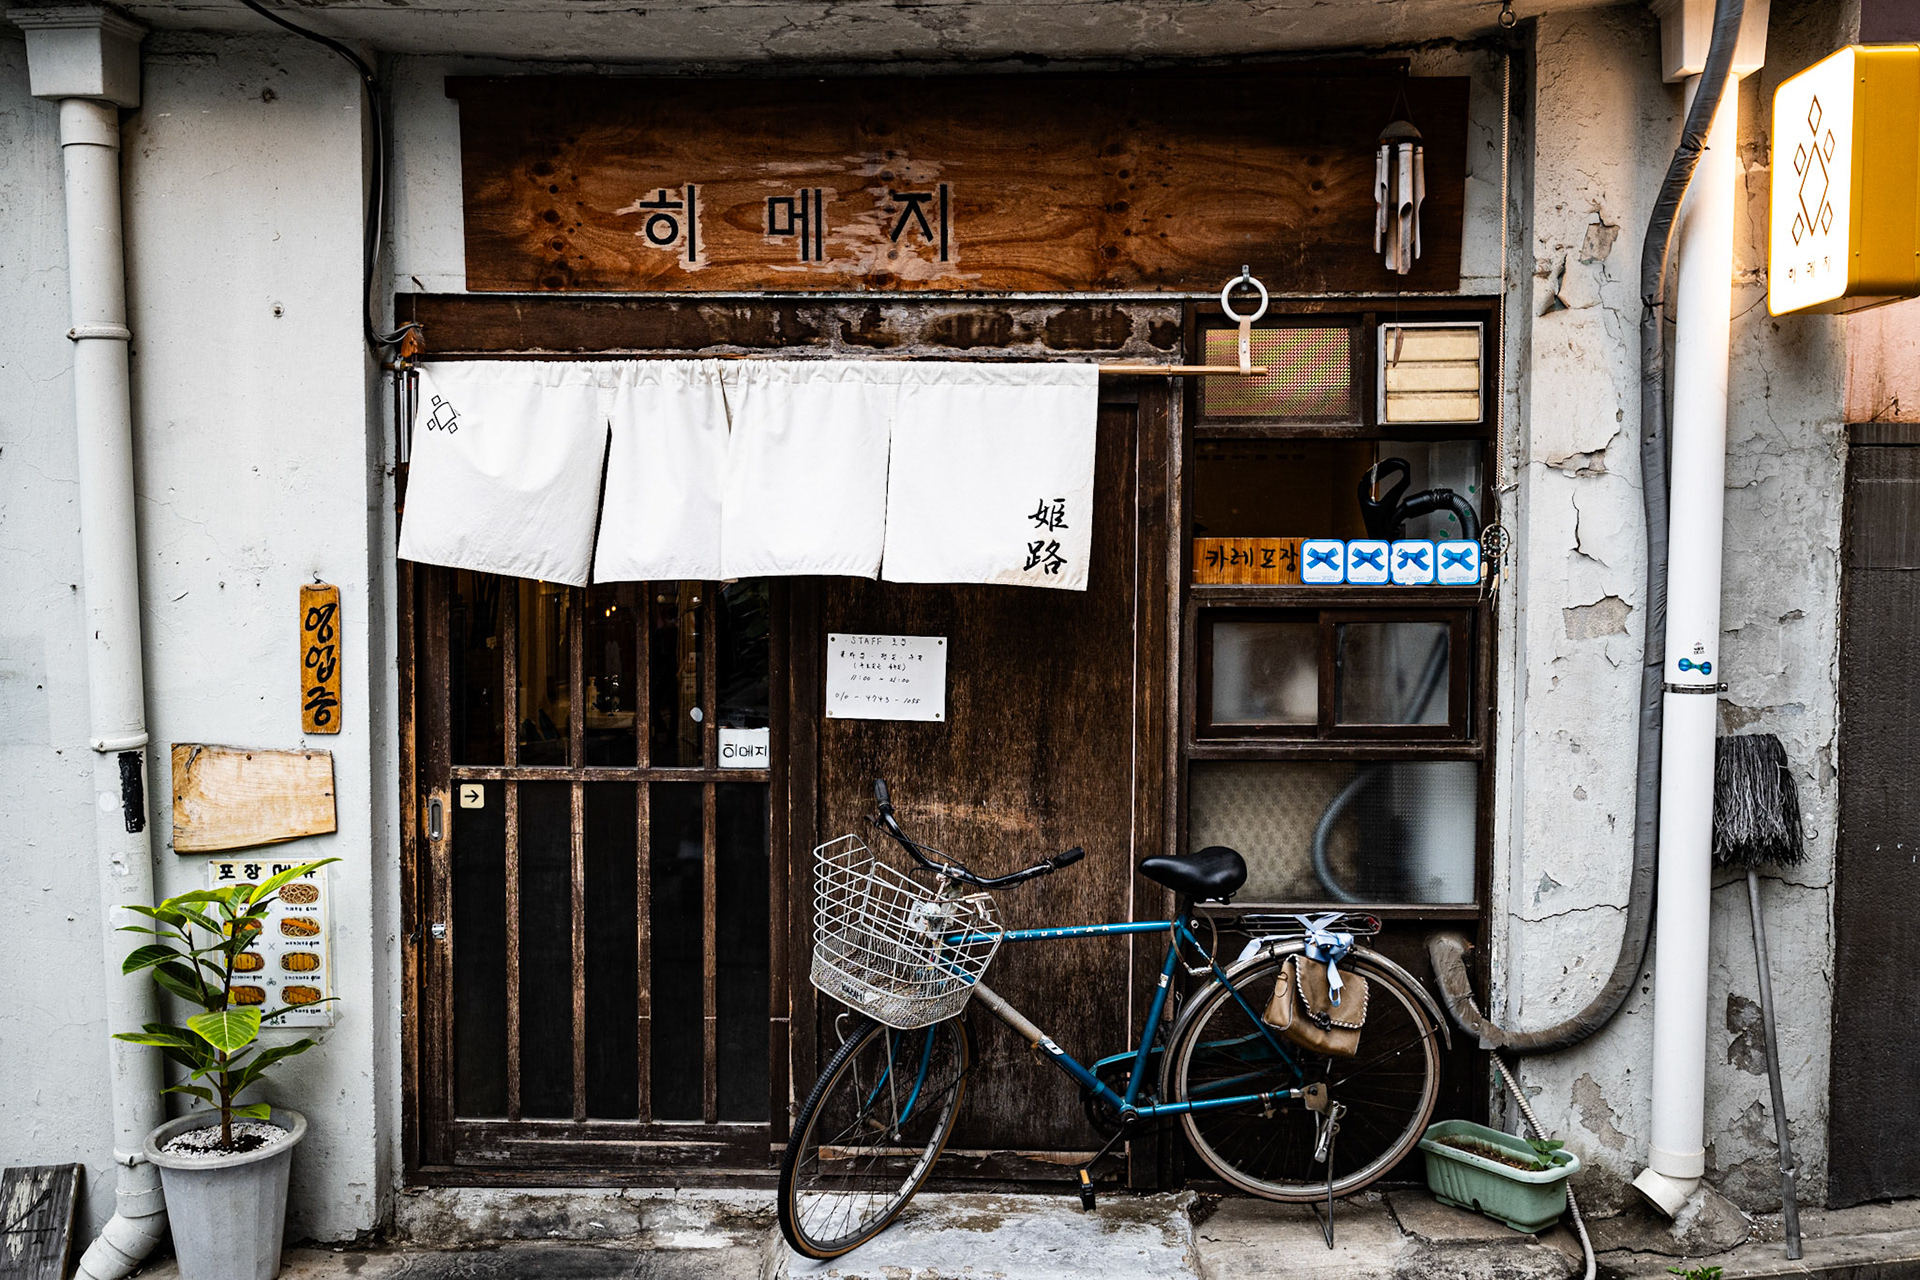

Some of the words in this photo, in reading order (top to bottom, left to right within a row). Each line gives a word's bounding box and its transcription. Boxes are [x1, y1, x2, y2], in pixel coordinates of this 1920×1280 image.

[640, 184, 948, 262] 히메지
[1205, 545, 1254, 572] 카레
[1260, 543, 1299, 572] 포장
[850, 636, 882, 646] STAFF
[304, 603, 338, 726] 영업중
[219, 863, 262, 880] 포장
